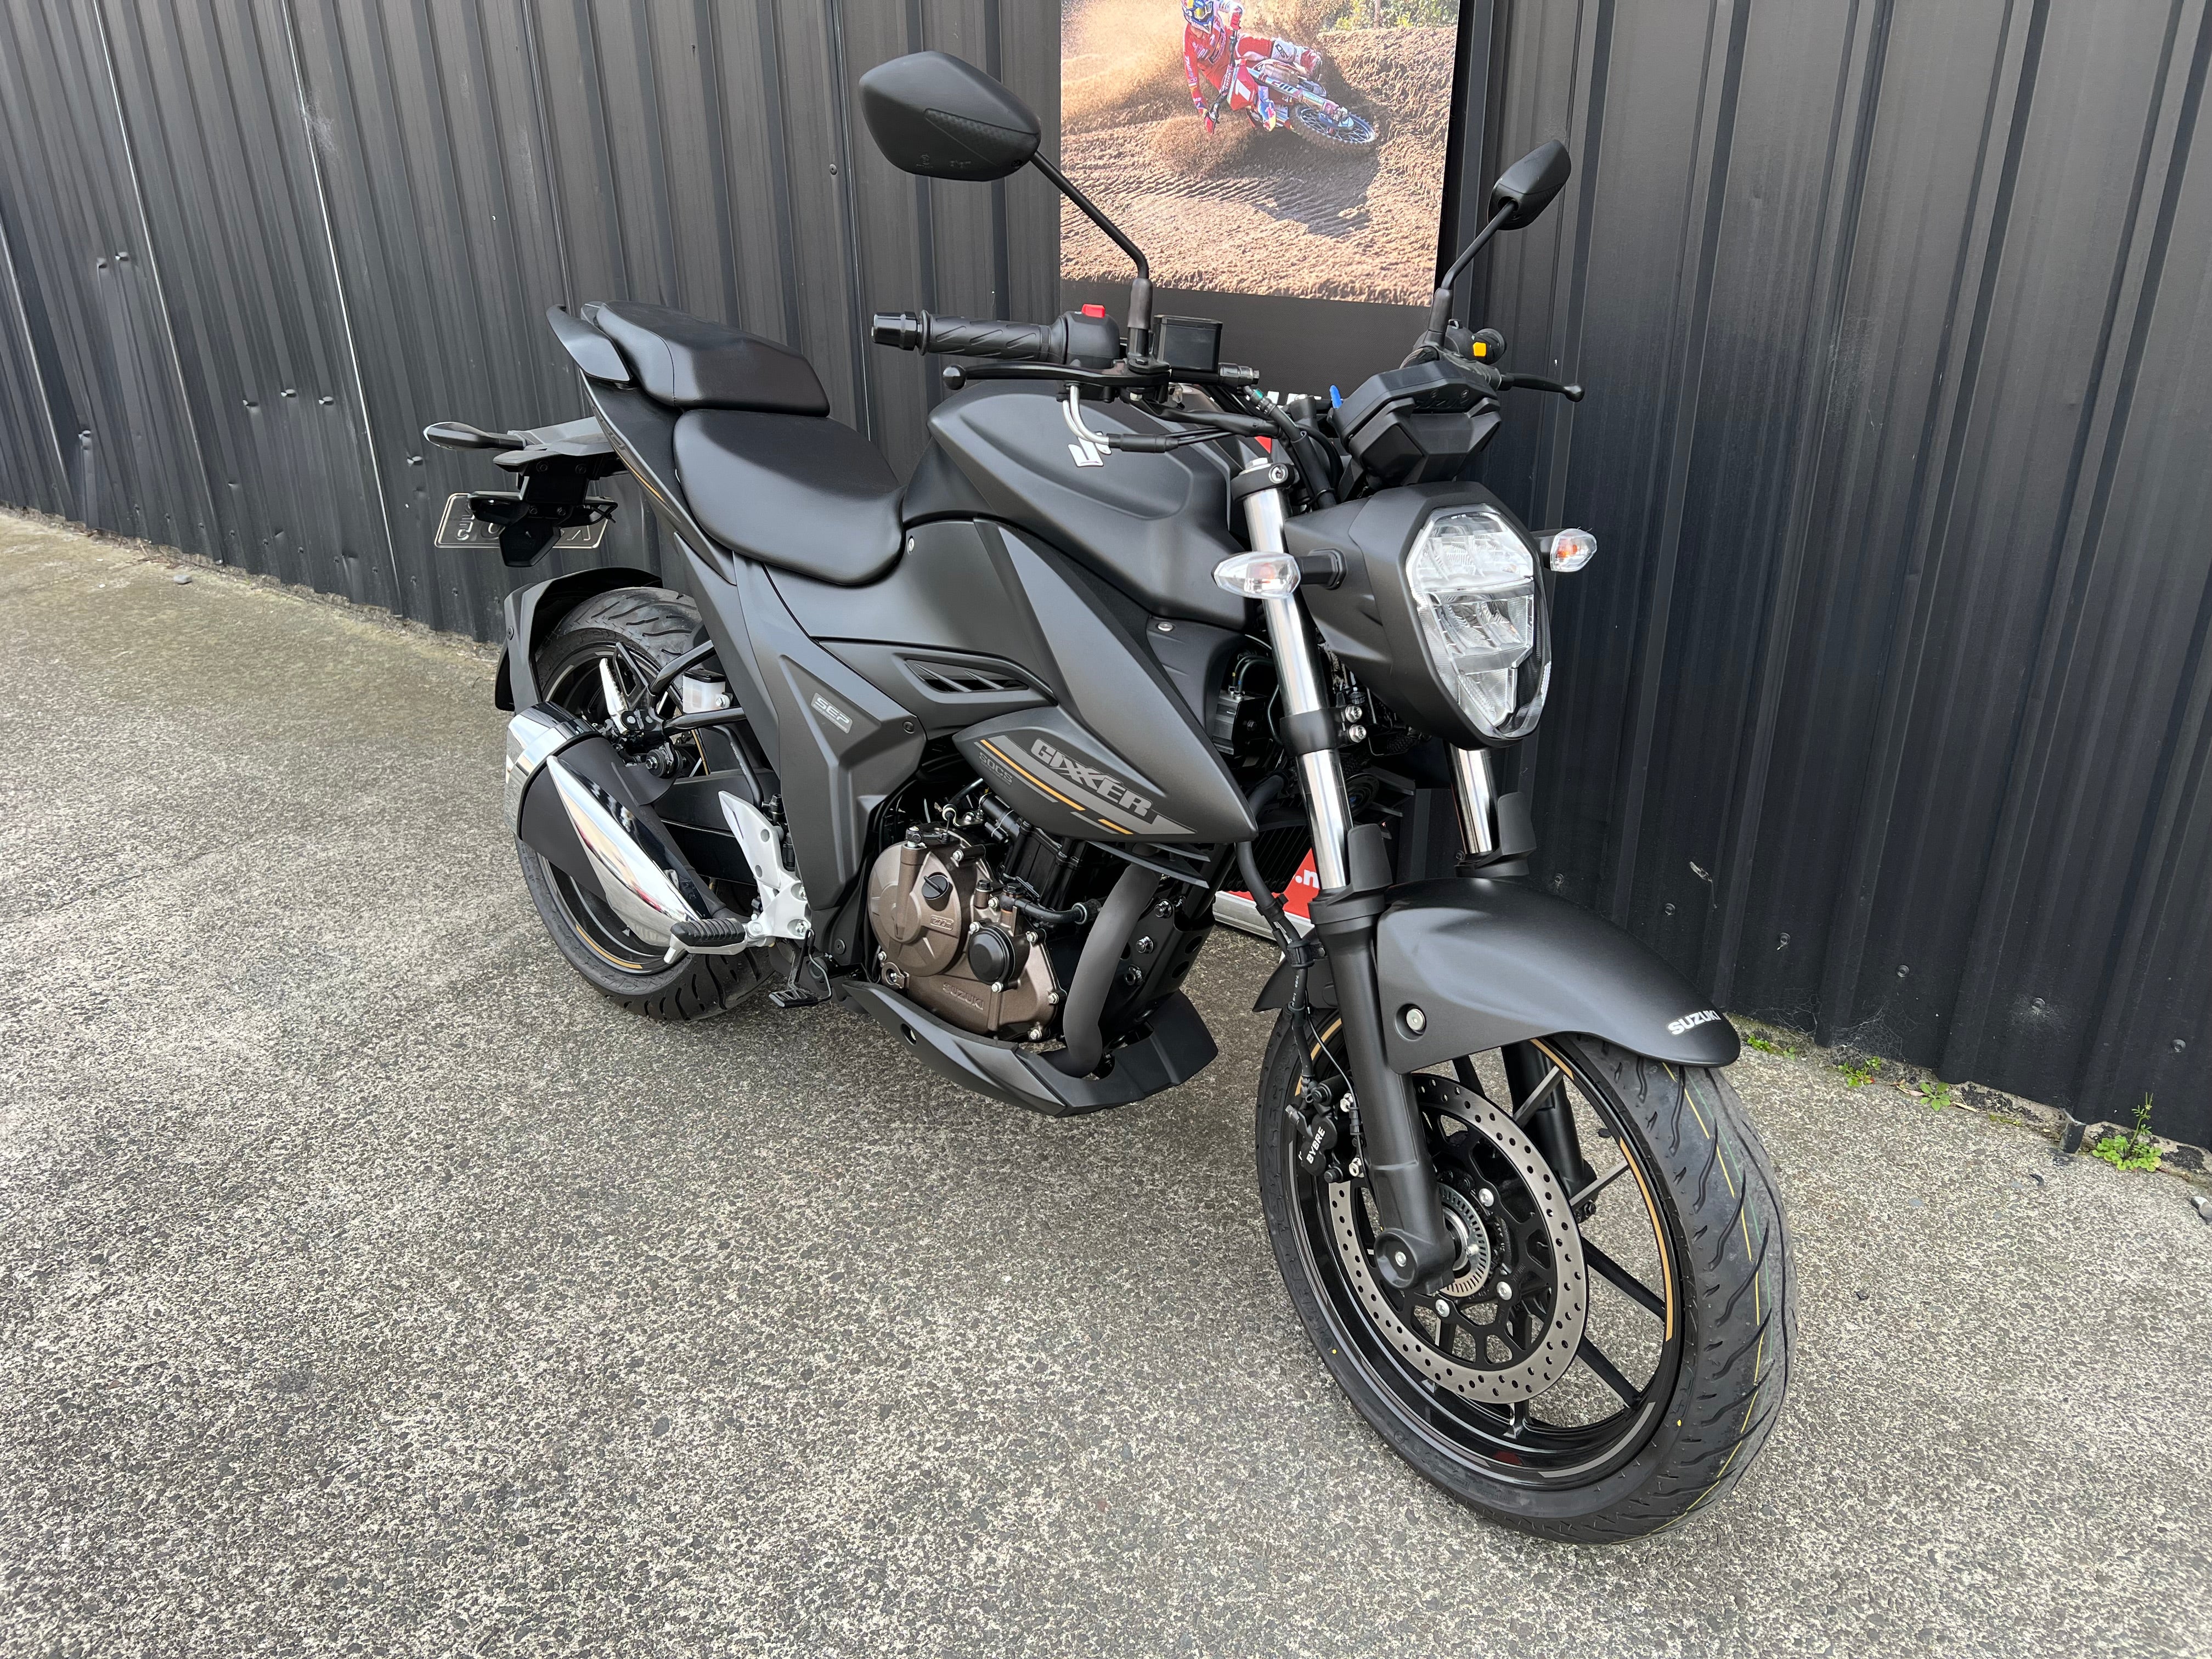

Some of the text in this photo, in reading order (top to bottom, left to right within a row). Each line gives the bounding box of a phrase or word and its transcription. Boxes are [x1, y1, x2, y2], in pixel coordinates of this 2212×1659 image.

[815, 697, 850, 724] SEP
[979, 752, 1013, 783] SOCS
[1031, 738, 1153, 817] GIXXER
[943, 982, 984, 1011] SUZUKI
[1668, 1009, 1722, 1035] SUZUKI
[1306, 1126, 1327, 1164] BYBRE
